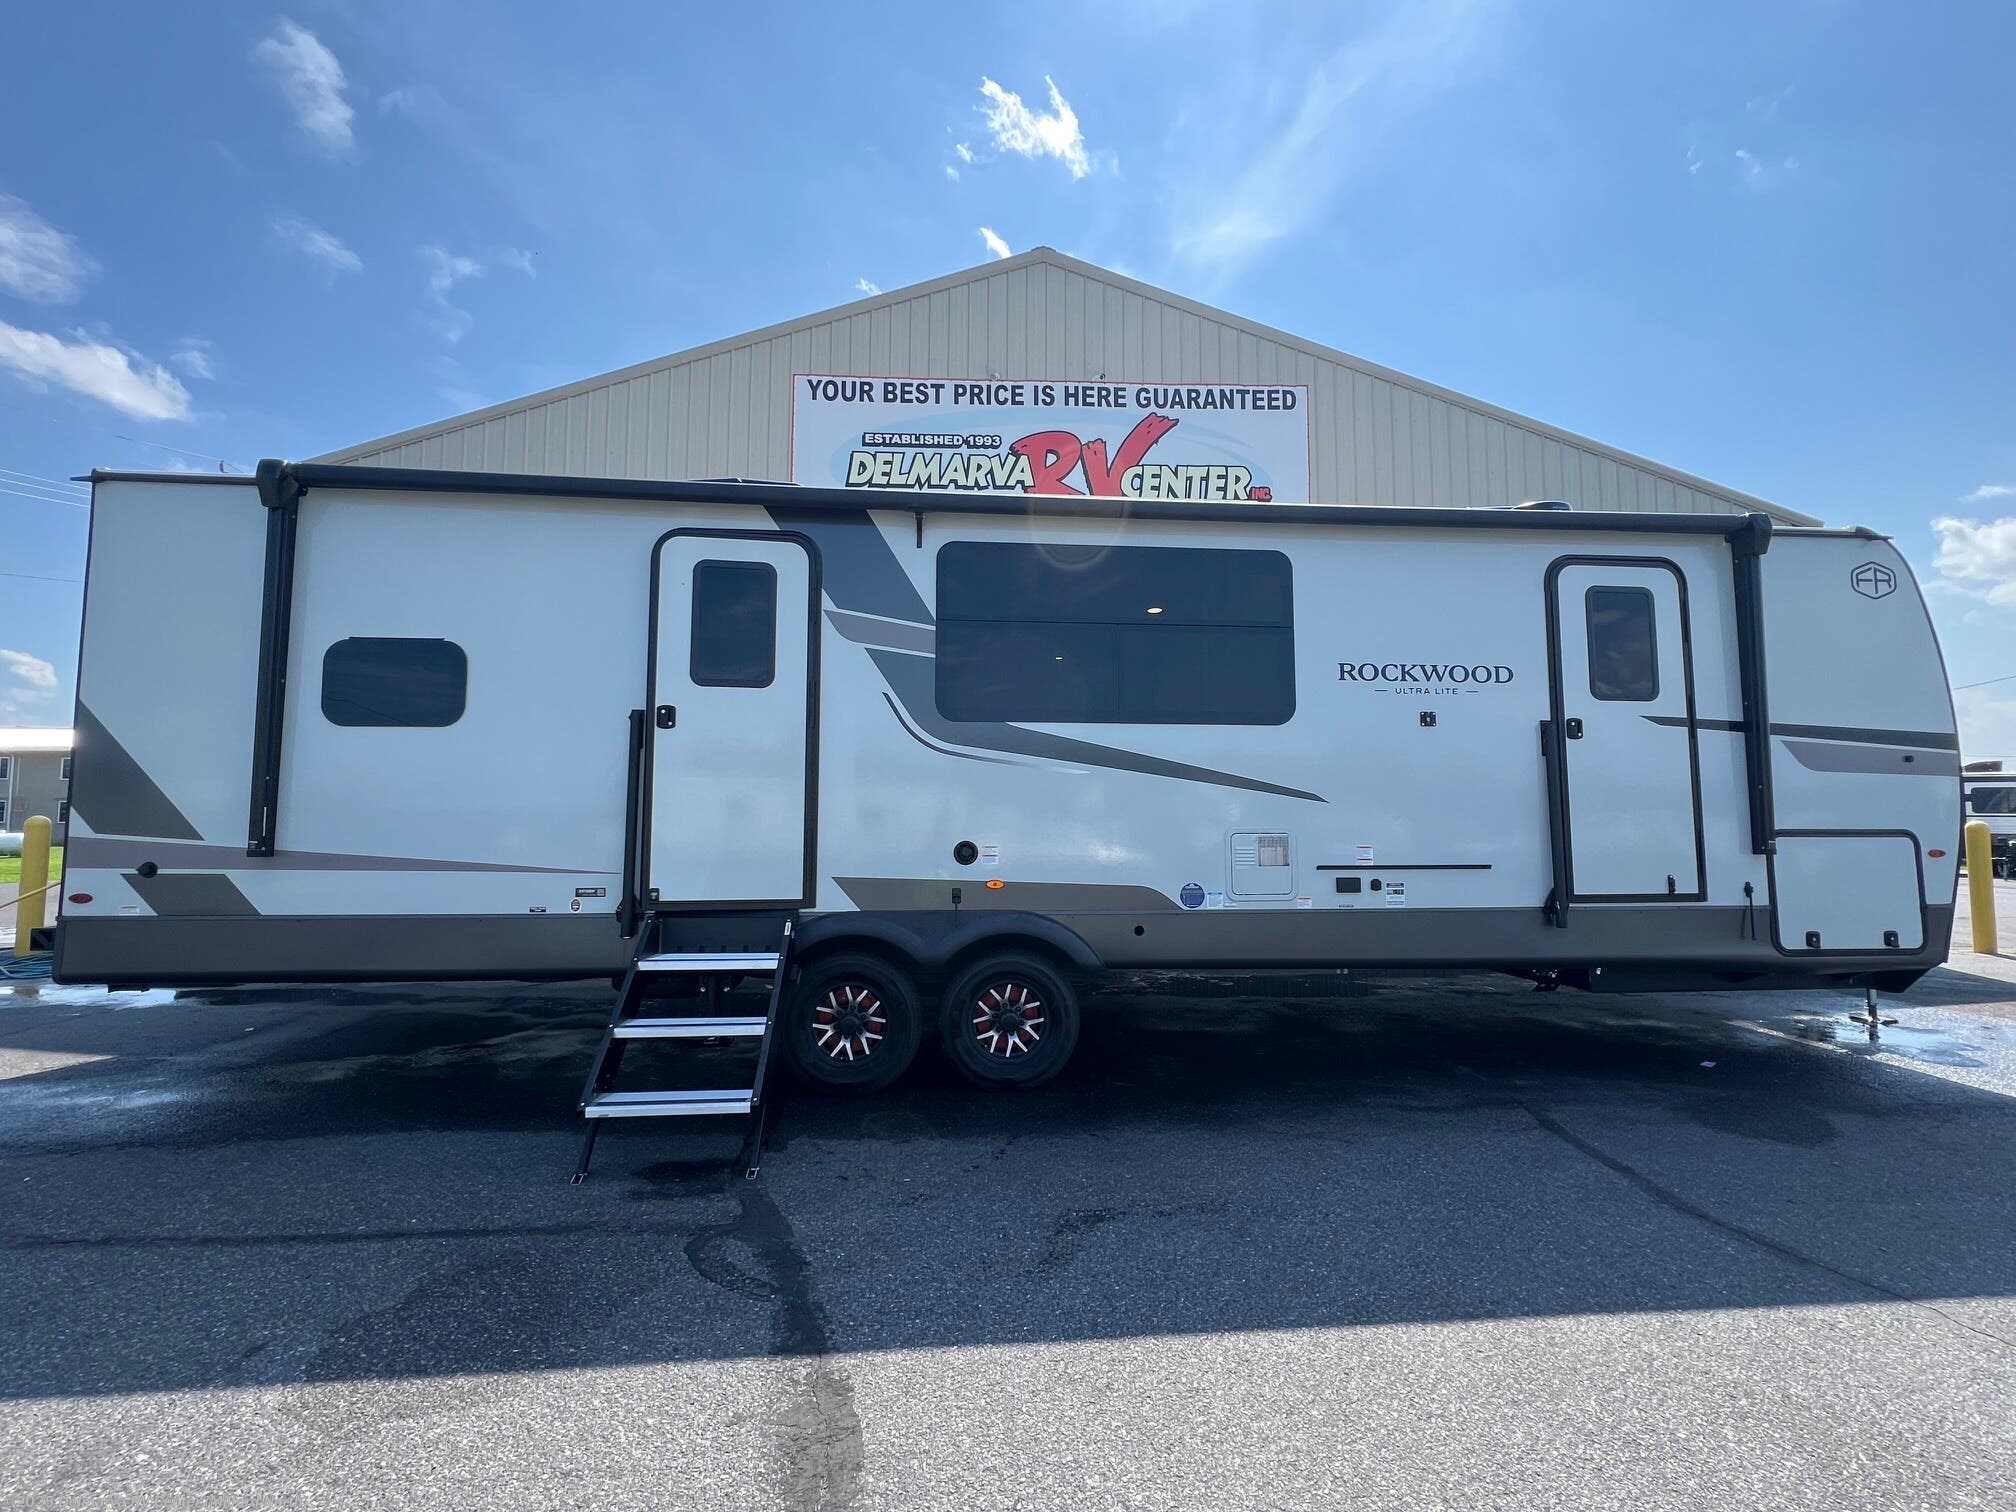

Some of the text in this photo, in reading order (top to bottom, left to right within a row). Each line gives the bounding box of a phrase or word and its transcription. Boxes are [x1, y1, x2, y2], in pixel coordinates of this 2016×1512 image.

[807, 379, 1297, 410] YOUR BEST PRICE IS HERE GUARANTEED
[864, 433, 1001, 446] ESTABLISHED 1993
[846, 451, 1035, 490] DELMARVA
[1010, 412, 1179, 496] RV
[1120, 464, 1252, 500] CENTER
[1337, 662, 1514, 684] ROCKWOOD
[1394, 687, 1459, 695] ULTRA LITE
